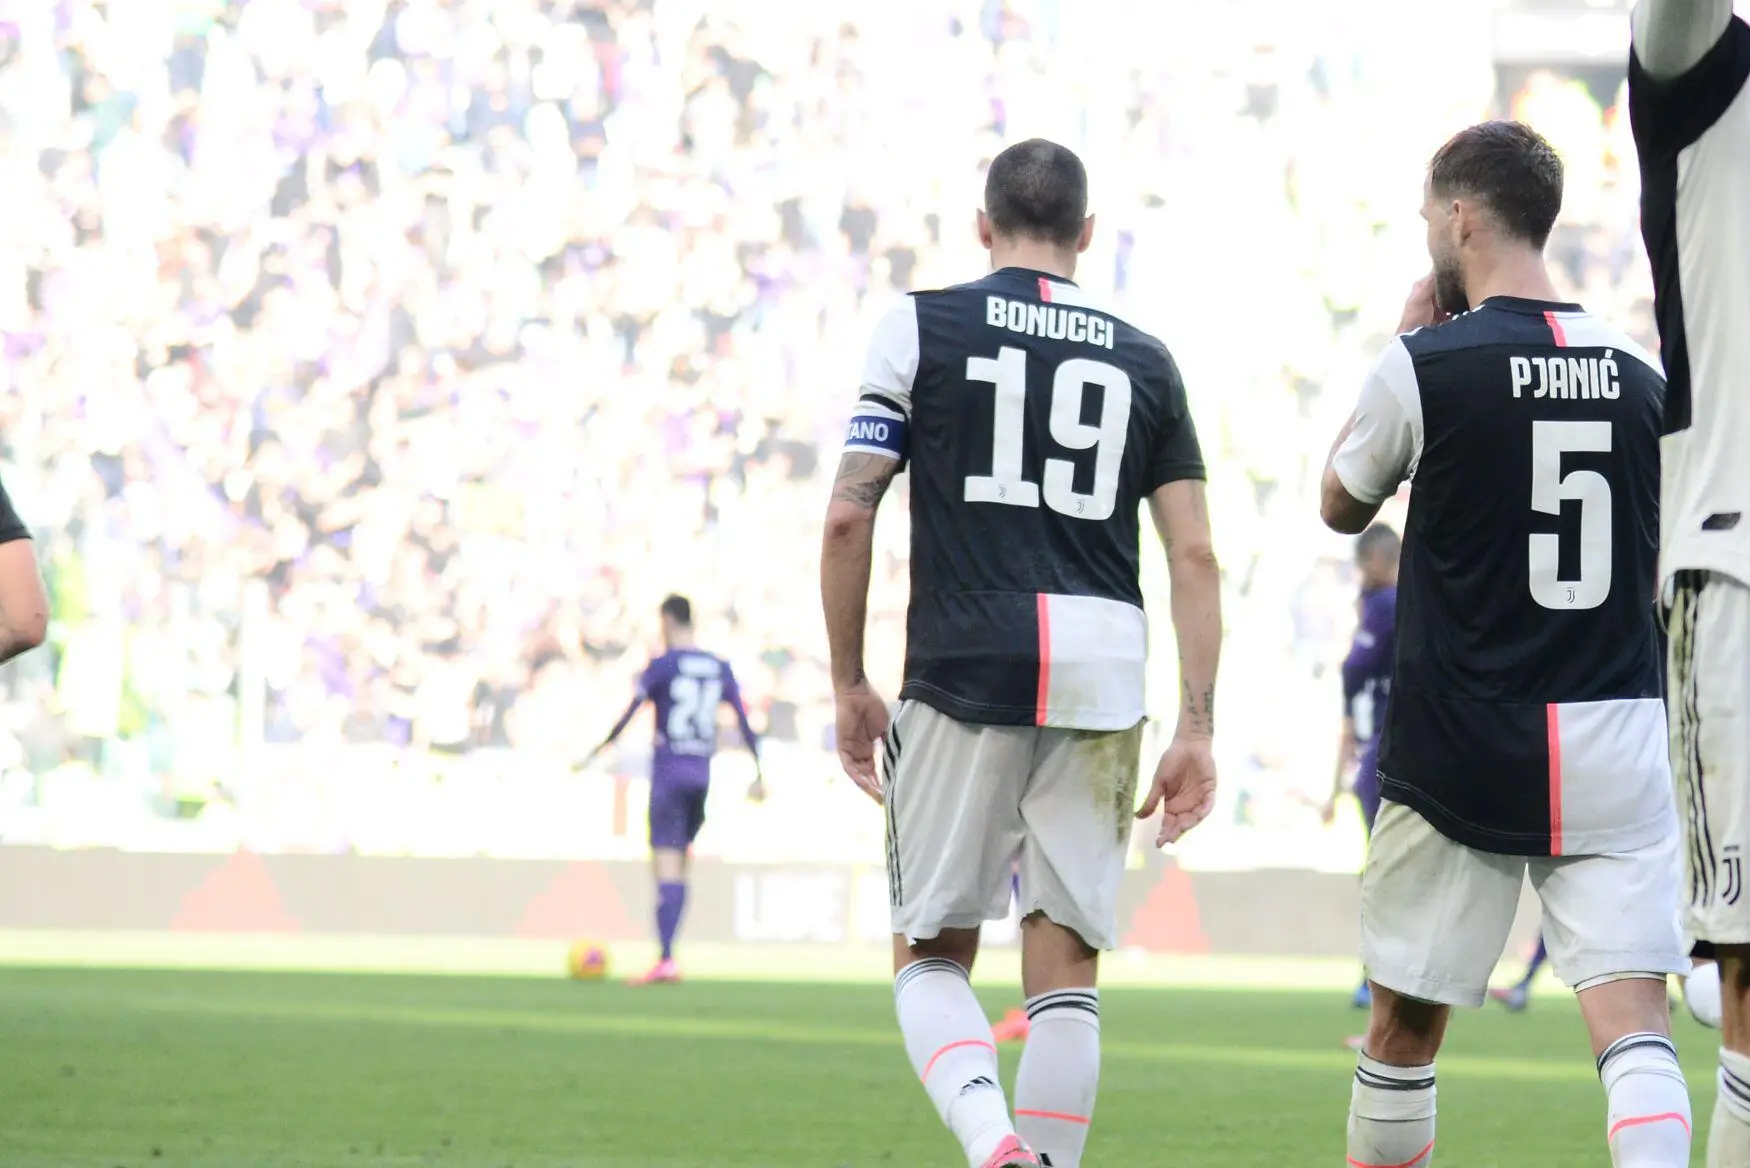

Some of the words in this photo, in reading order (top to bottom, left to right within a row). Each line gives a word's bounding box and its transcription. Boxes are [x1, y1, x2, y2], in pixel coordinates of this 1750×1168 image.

[986, 295, 1114, 350] BONUCCI
[1509, 348, 1620, 399] PJANIĆ
[963, 345, 1132, 521] 19
[1528, 420, 1612, 610] 5
